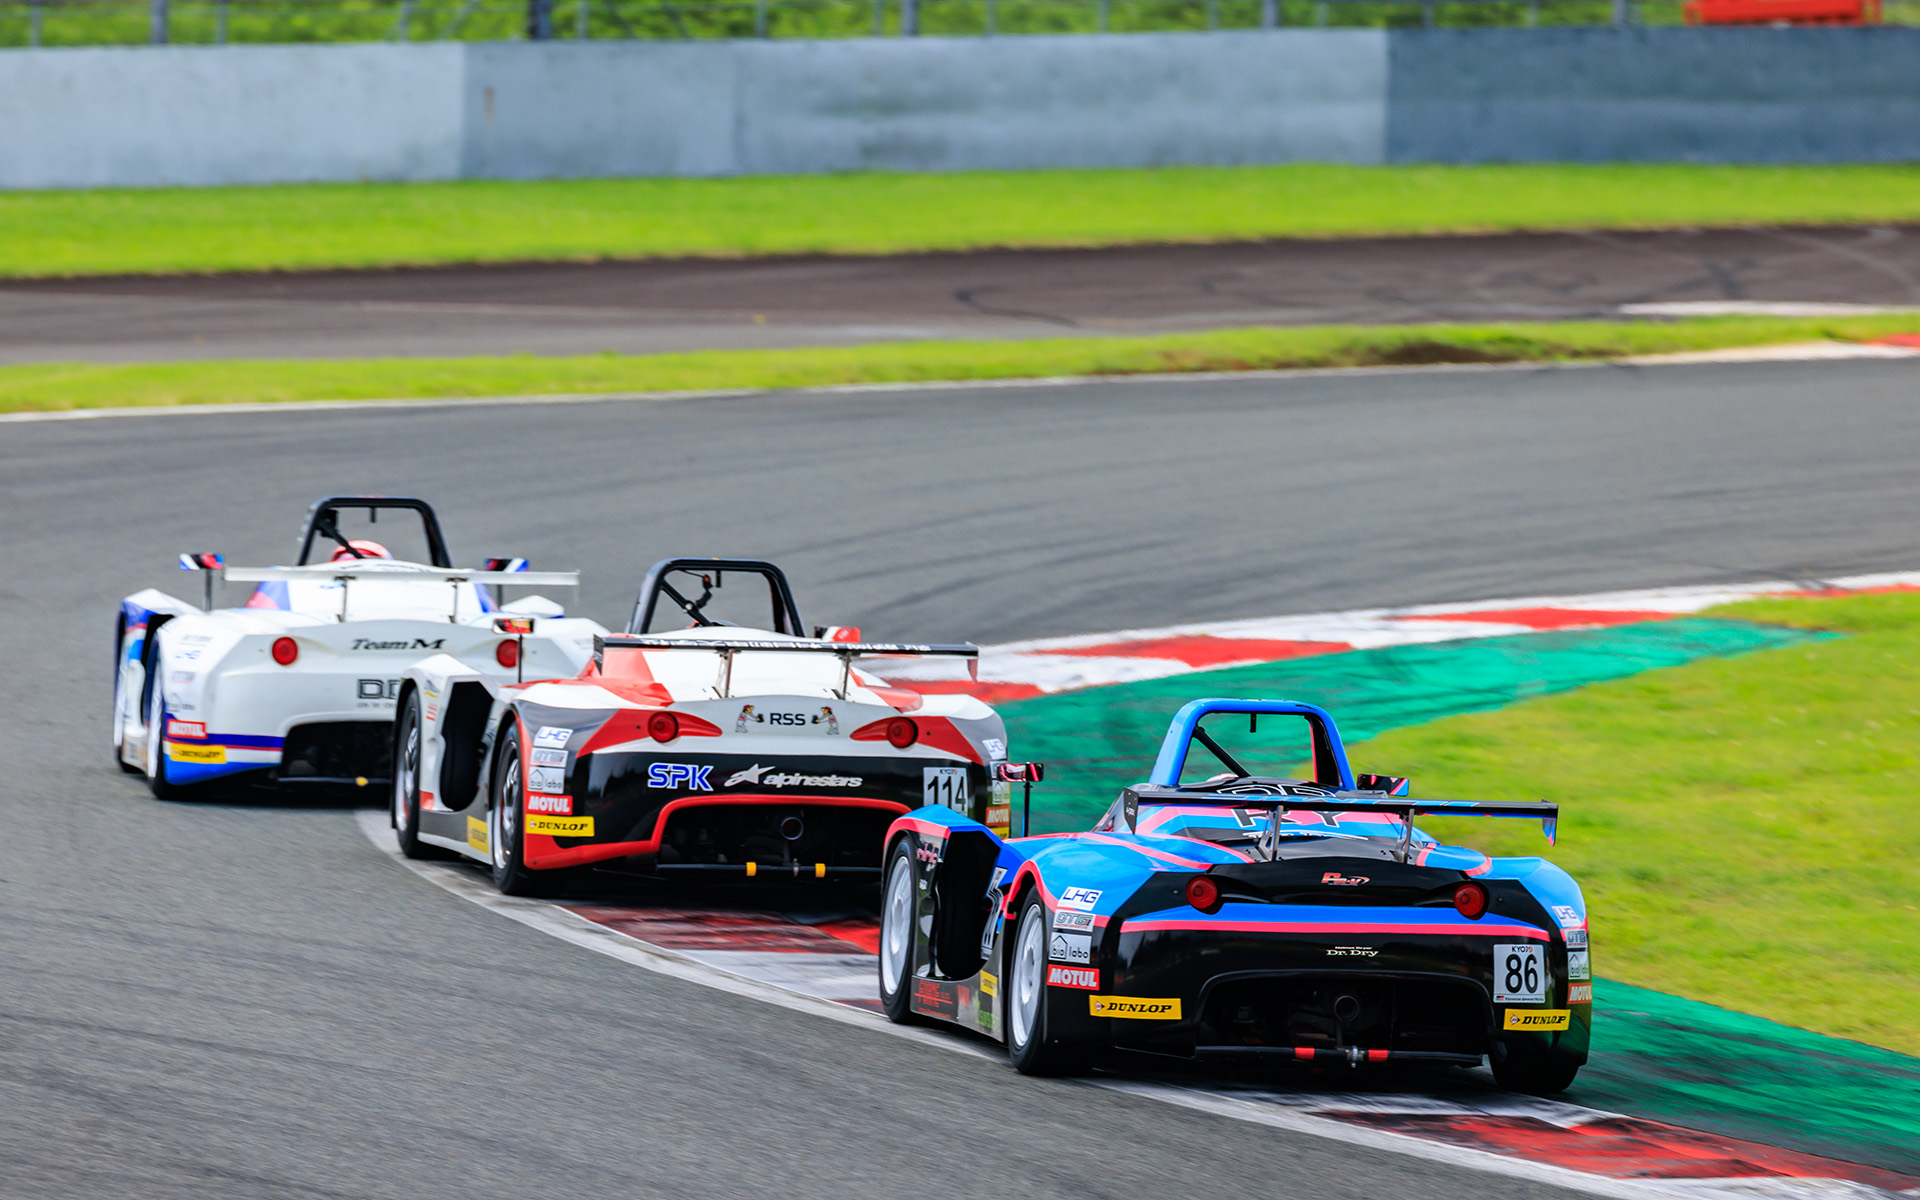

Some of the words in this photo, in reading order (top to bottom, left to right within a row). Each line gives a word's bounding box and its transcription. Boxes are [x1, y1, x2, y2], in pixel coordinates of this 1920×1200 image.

[351, 638, 408, 650] Team
[410, 638, 448, 649] M
[769, 712, 806, 726] RSS
[538, 729, 570, 742] LHG
[648, 762, 714, 792] SPK
[763, 772, 863, 788] alpinestars
[927, 776, 967, 811] 114
[528, 796, 570, 812] MOTUL
[987, 808, 1009, 823] MOTU
[538, 822, 588, 831] DUNLOP
[1063, 889, 1100, 903] LHG
[1069, 946, 1089, 959] labo
[1350, 950, 1379, 958] Dry
[1050, 968, 1097, 987] MOTUL
[1505, 953, 1539, 994] 86
[1107, 1002, 1172, 1014] DUNLOP
[1521, 1015, 1567, 1025] DUNLOP
